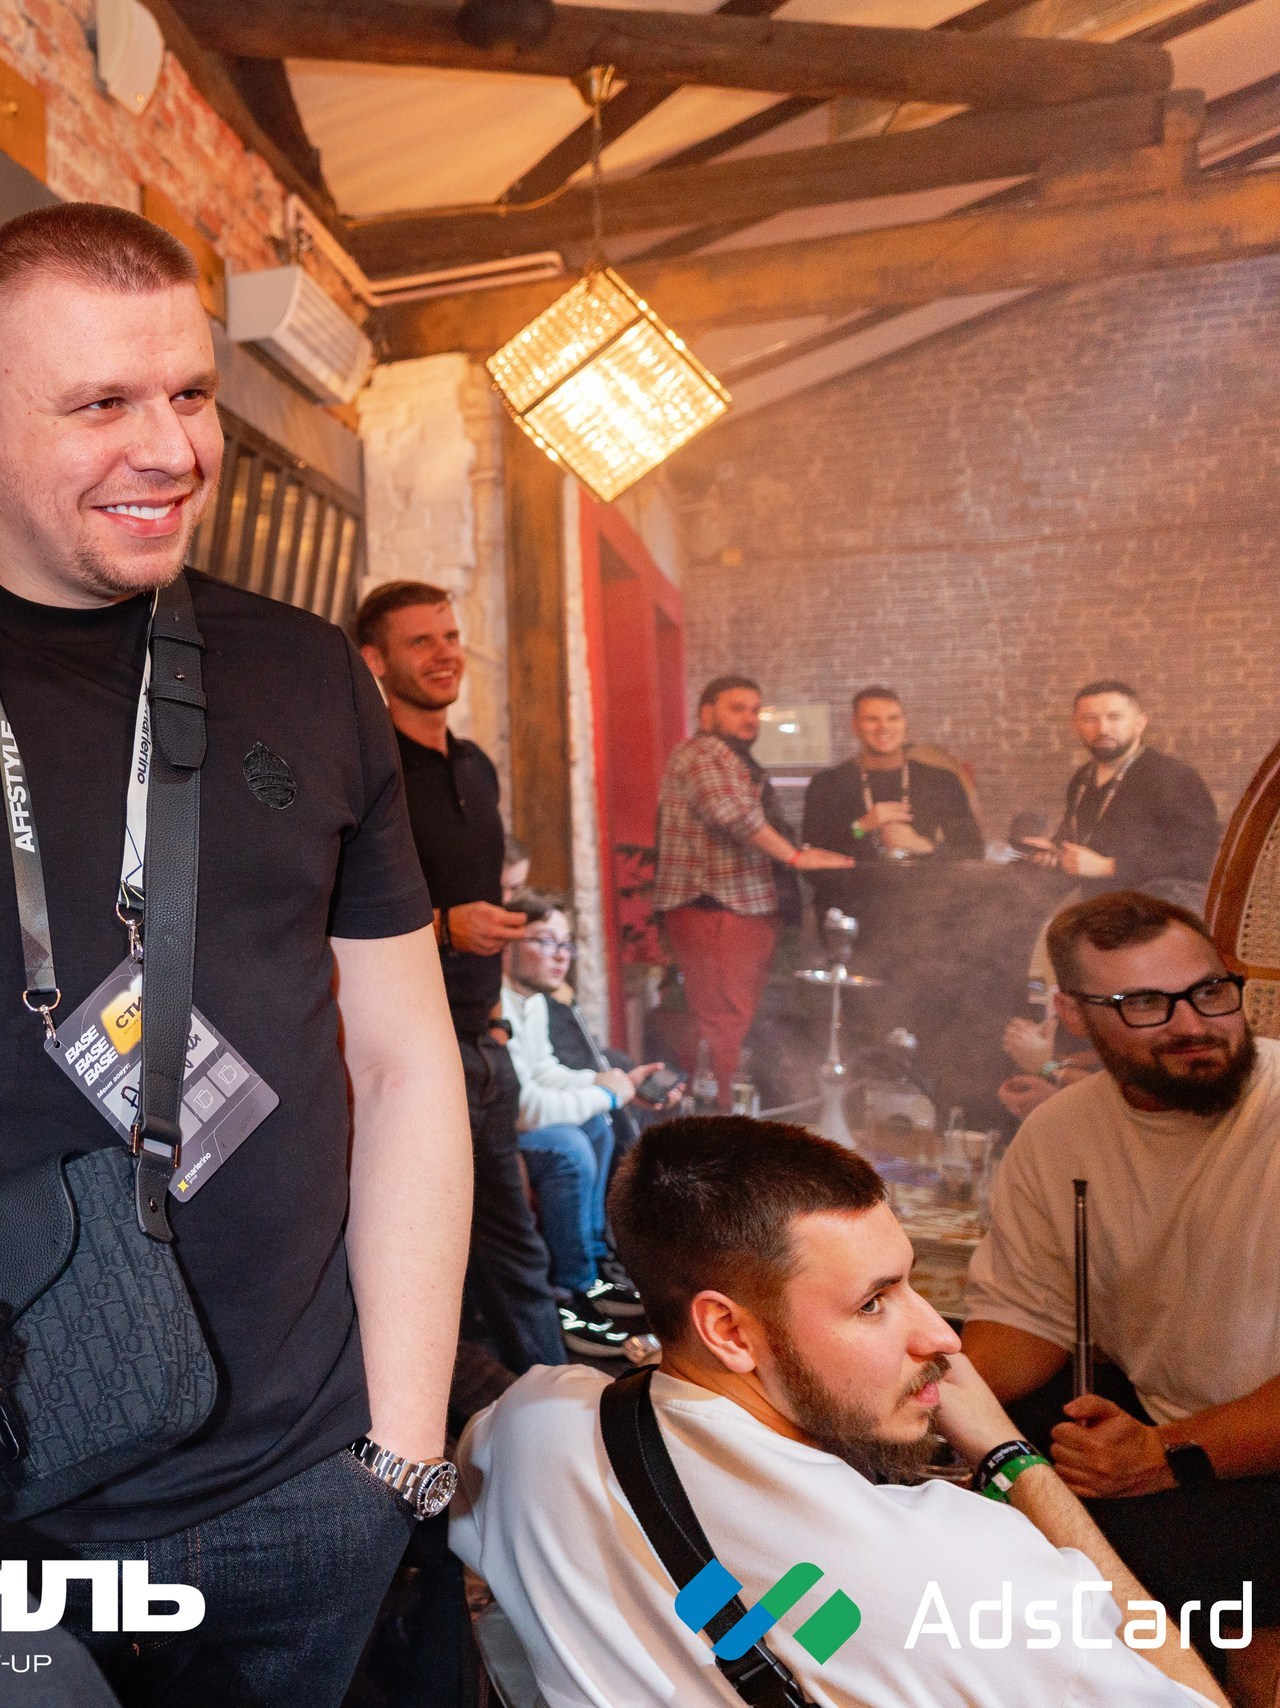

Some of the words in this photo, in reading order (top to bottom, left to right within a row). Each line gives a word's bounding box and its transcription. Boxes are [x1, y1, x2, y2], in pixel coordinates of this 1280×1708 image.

[0, 720, 35, 853] AFFSTYLE
[115, 996, 142, 1029] СТИ
[64, 1024, 99, 1065] BASE
[74, 1036, 109, 1077] BASE
[83, 1046, 119, 1087] BASE
[96, 1080, 114, 1099] Меня
[185, 1152, 212, 1181] marlerino
